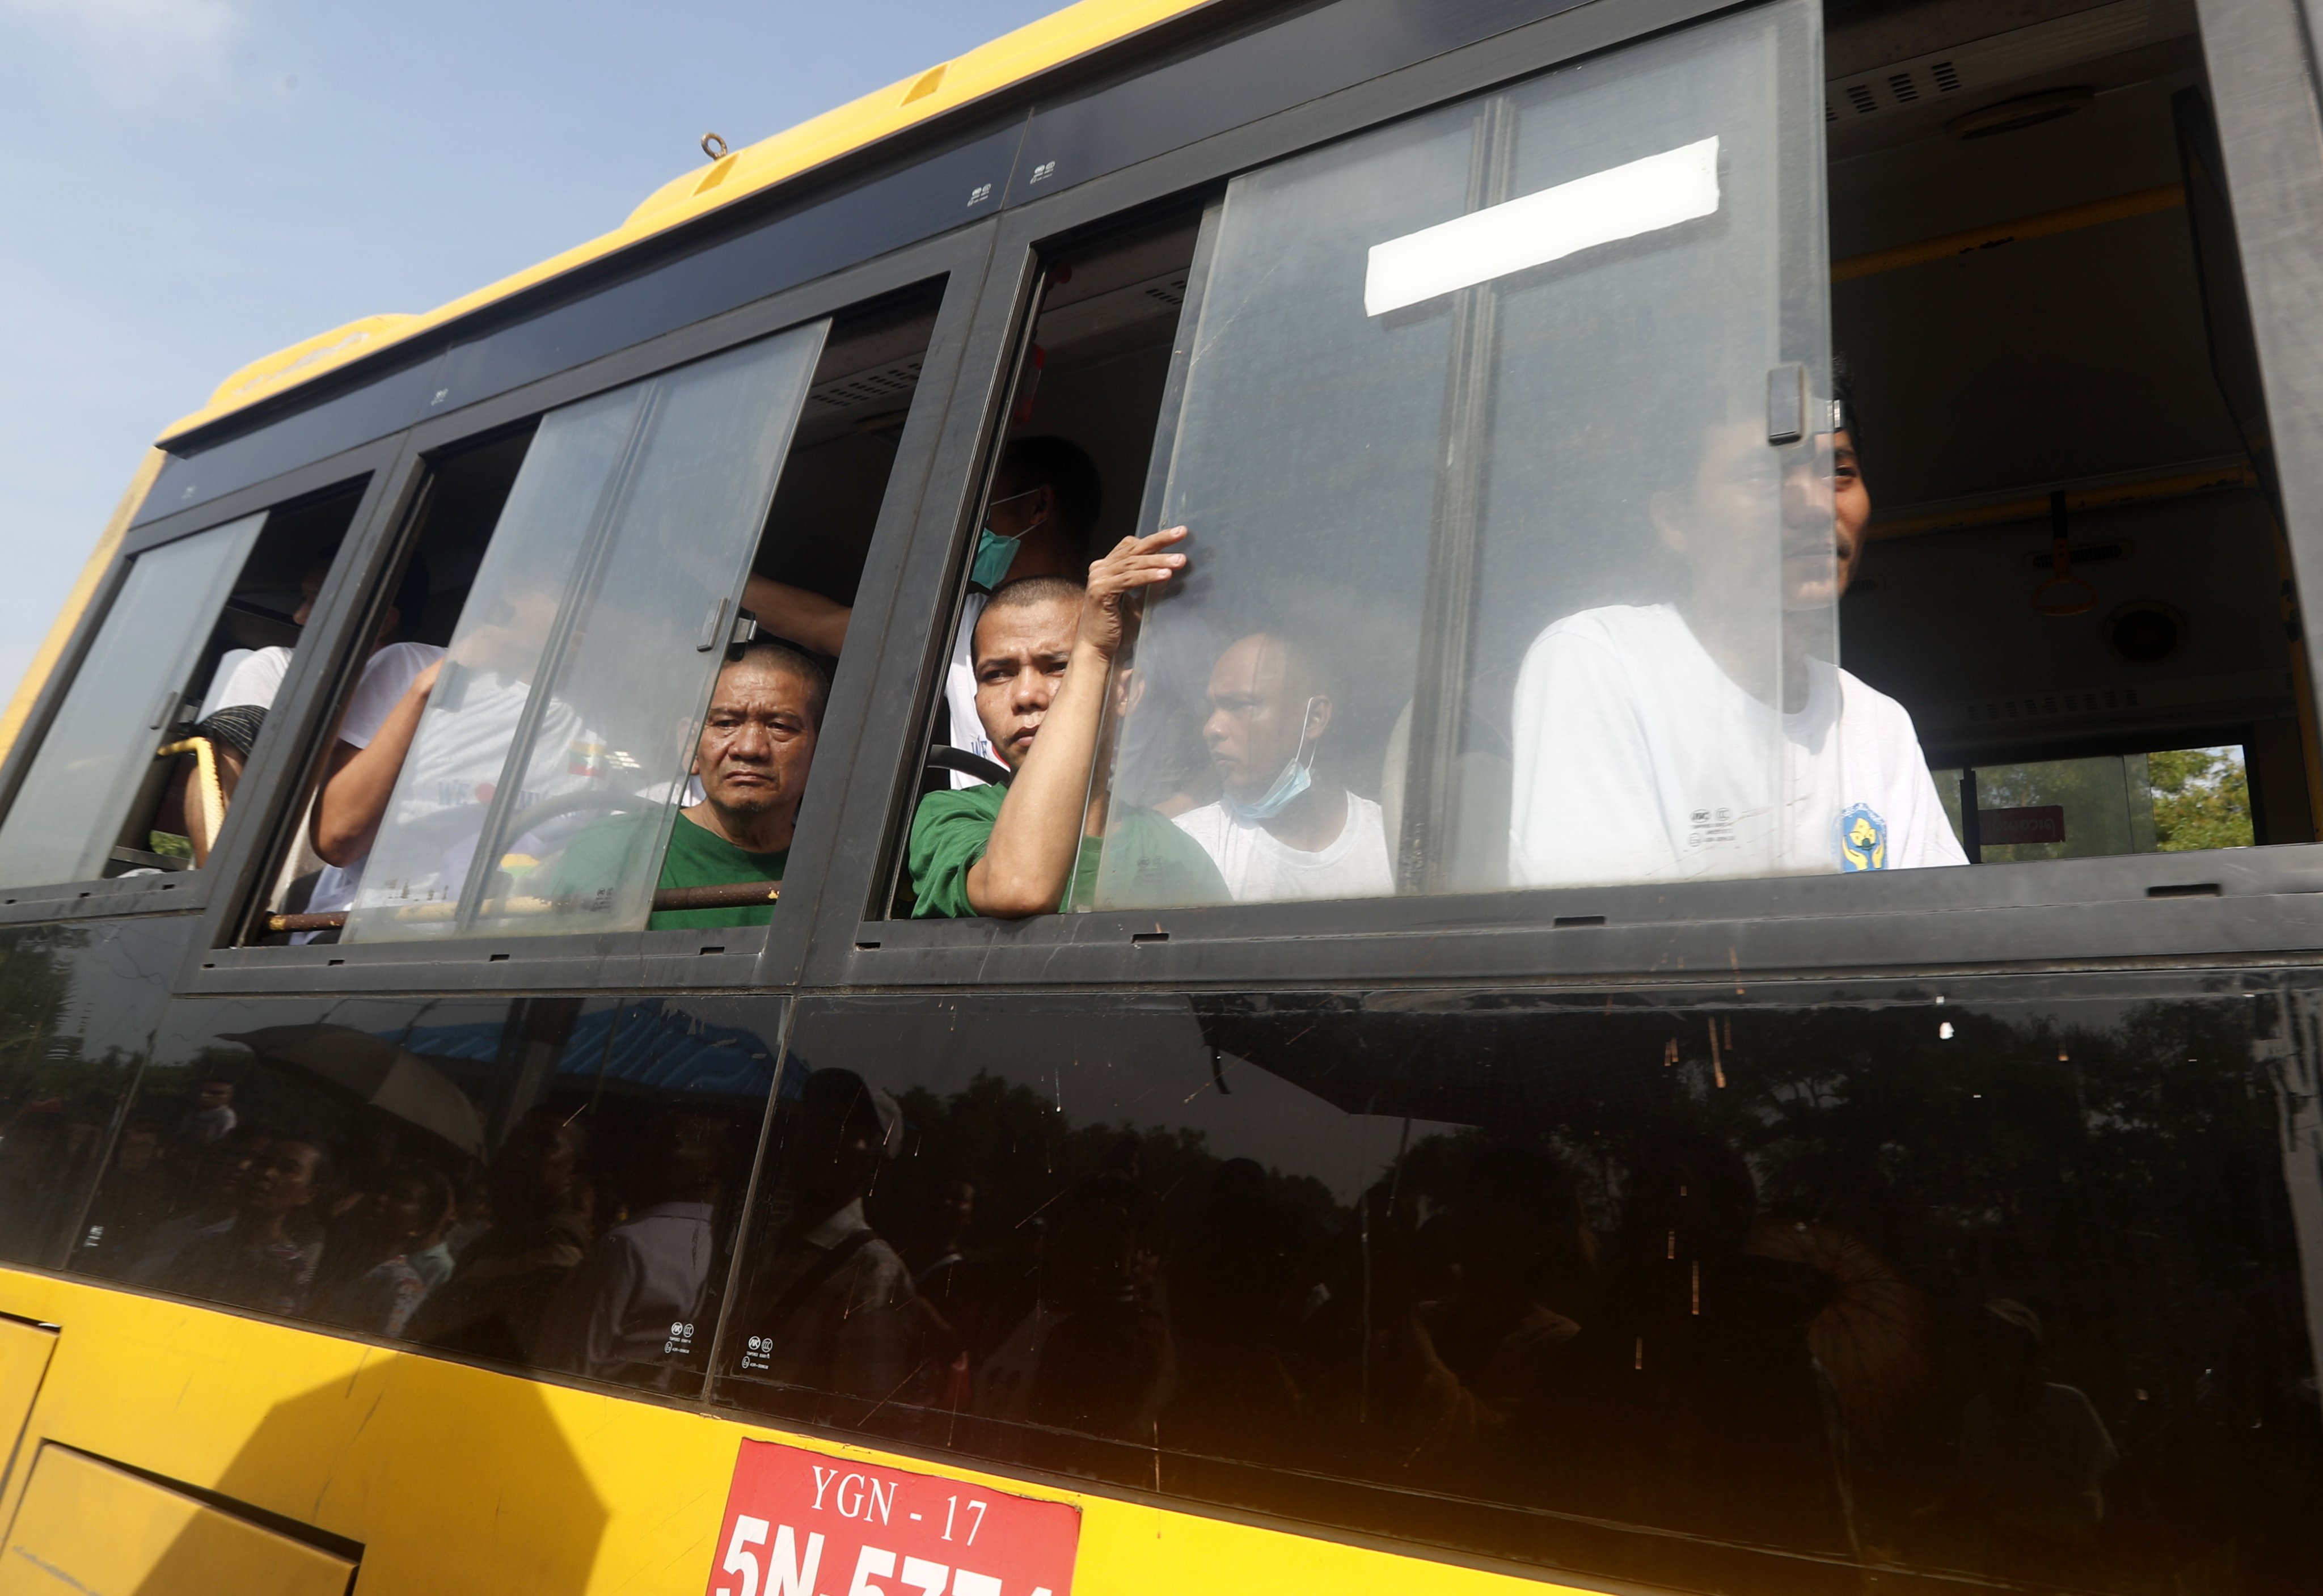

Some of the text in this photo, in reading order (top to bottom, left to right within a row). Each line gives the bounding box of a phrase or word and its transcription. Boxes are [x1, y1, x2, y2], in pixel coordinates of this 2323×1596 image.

[811, 1465, 987, 1547] YGN - 17
